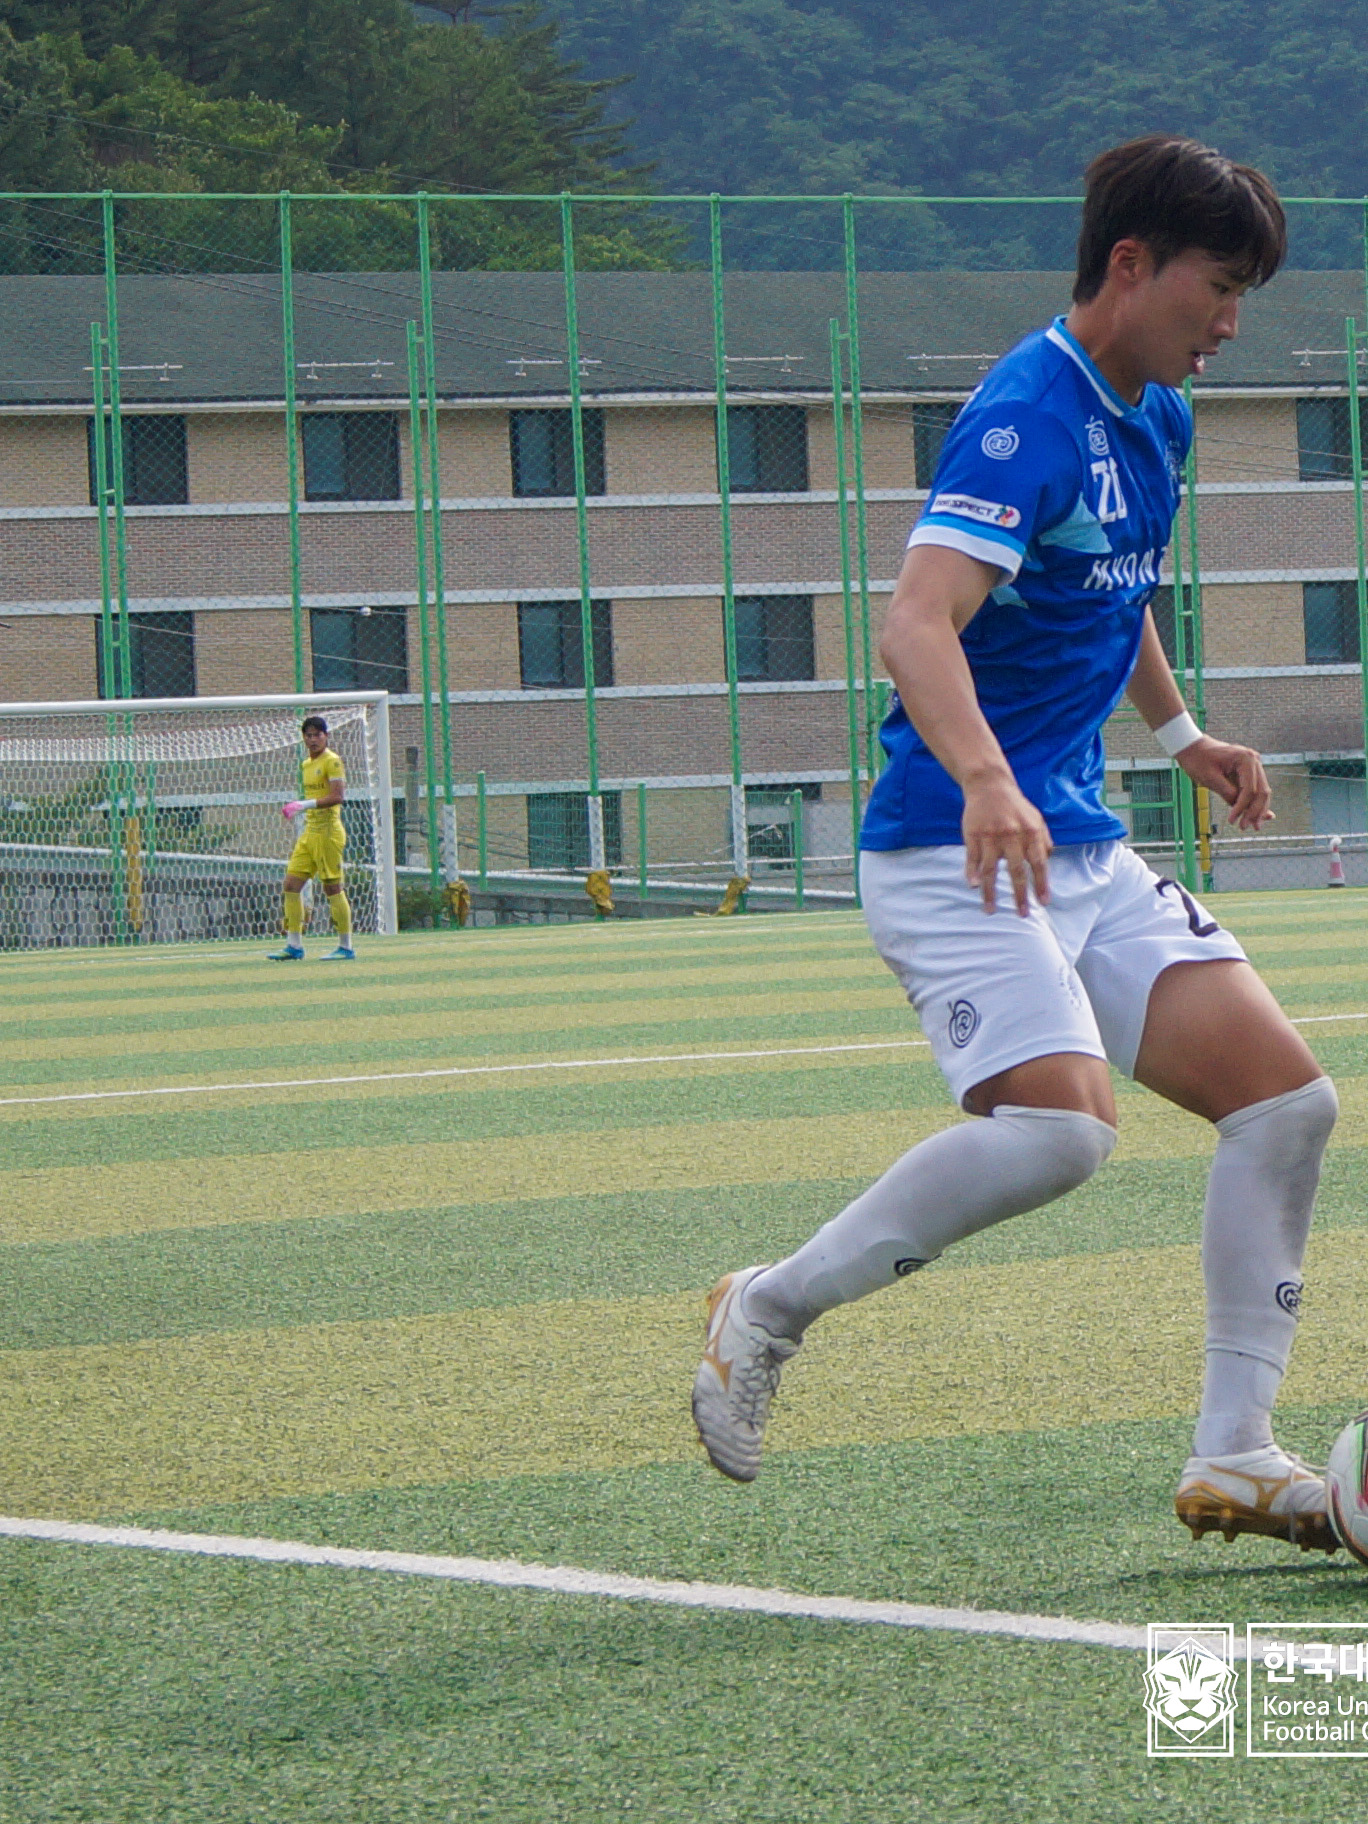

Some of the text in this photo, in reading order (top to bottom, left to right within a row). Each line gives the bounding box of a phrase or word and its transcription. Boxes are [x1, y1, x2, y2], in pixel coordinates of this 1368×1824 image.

[1090, 456, 1127, 523] 21
[1082, 546, 1167, 592] MYON
[1154, 877, 1221, 937] 2
